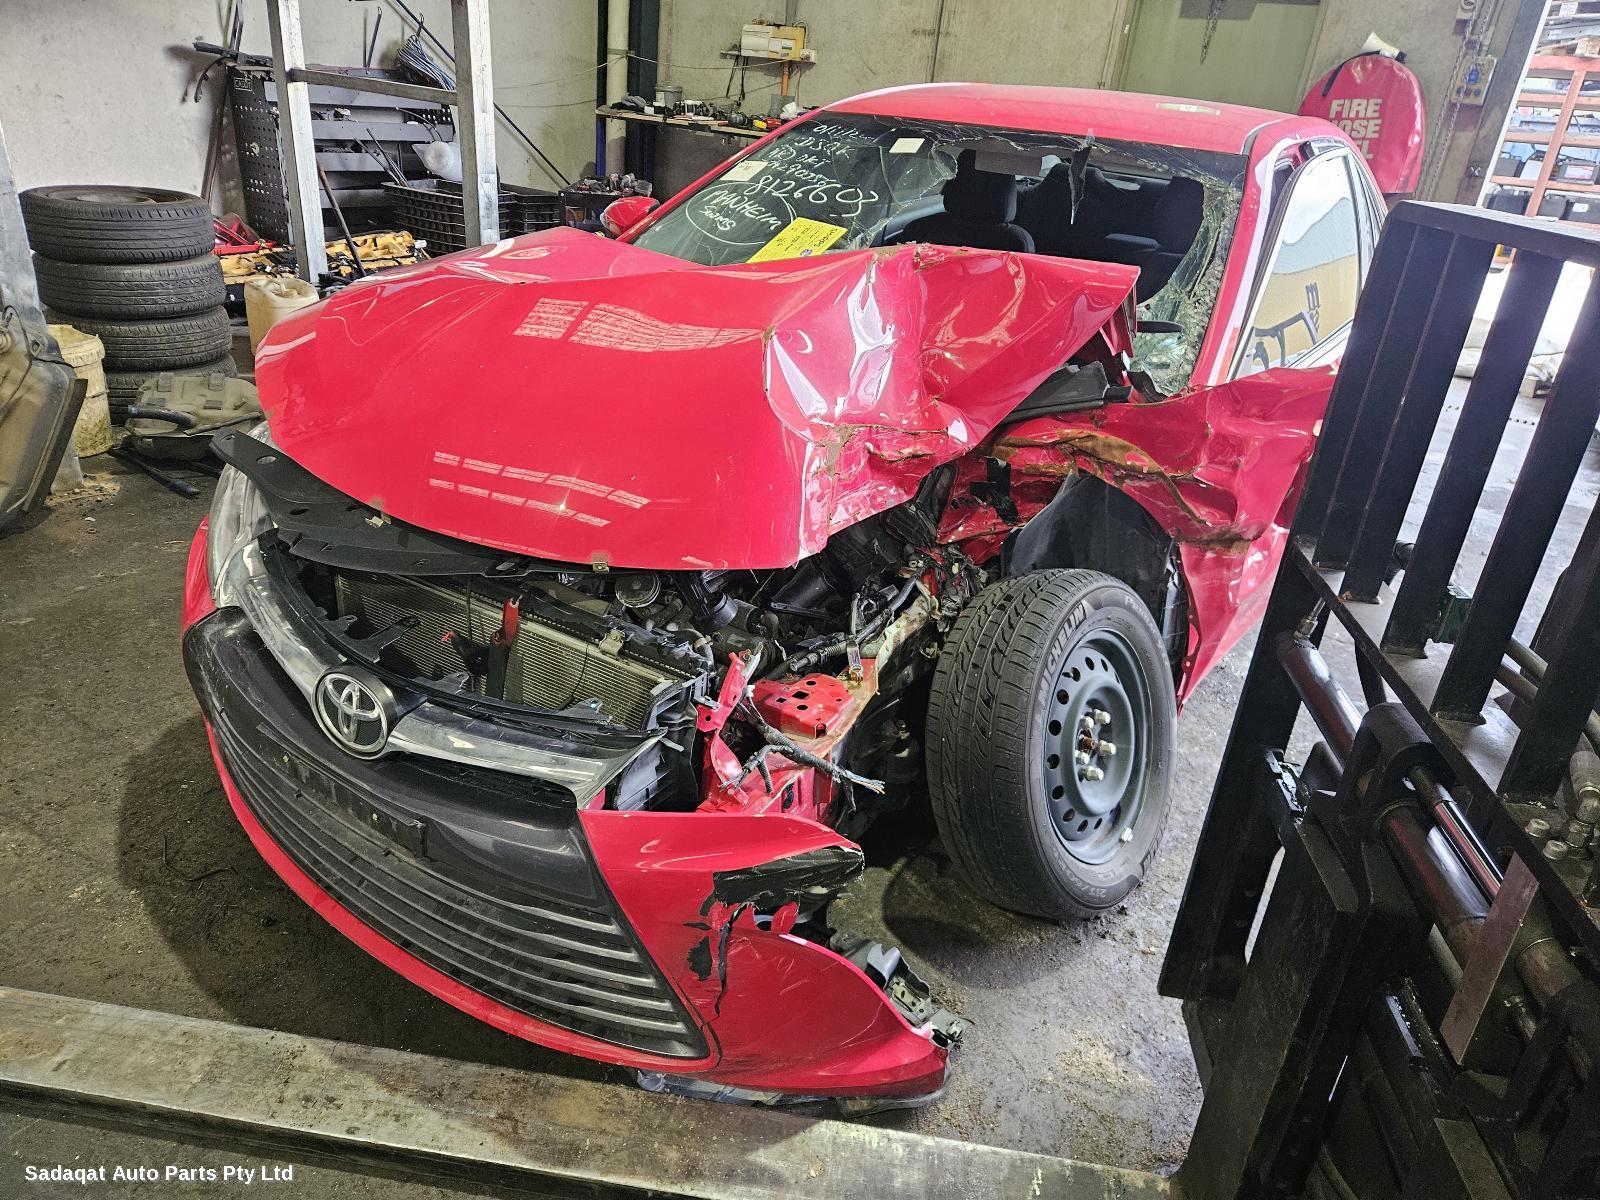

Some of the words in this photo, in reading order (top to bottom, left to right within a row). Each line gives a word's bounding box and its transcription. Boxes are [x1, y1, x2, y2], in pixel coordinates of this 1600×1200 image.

[1329, 98, 1382, 118] FIRE
[703, 190, 782, 231] MANHEIM
[1036, 601, 1086, 707] MICHELIN
